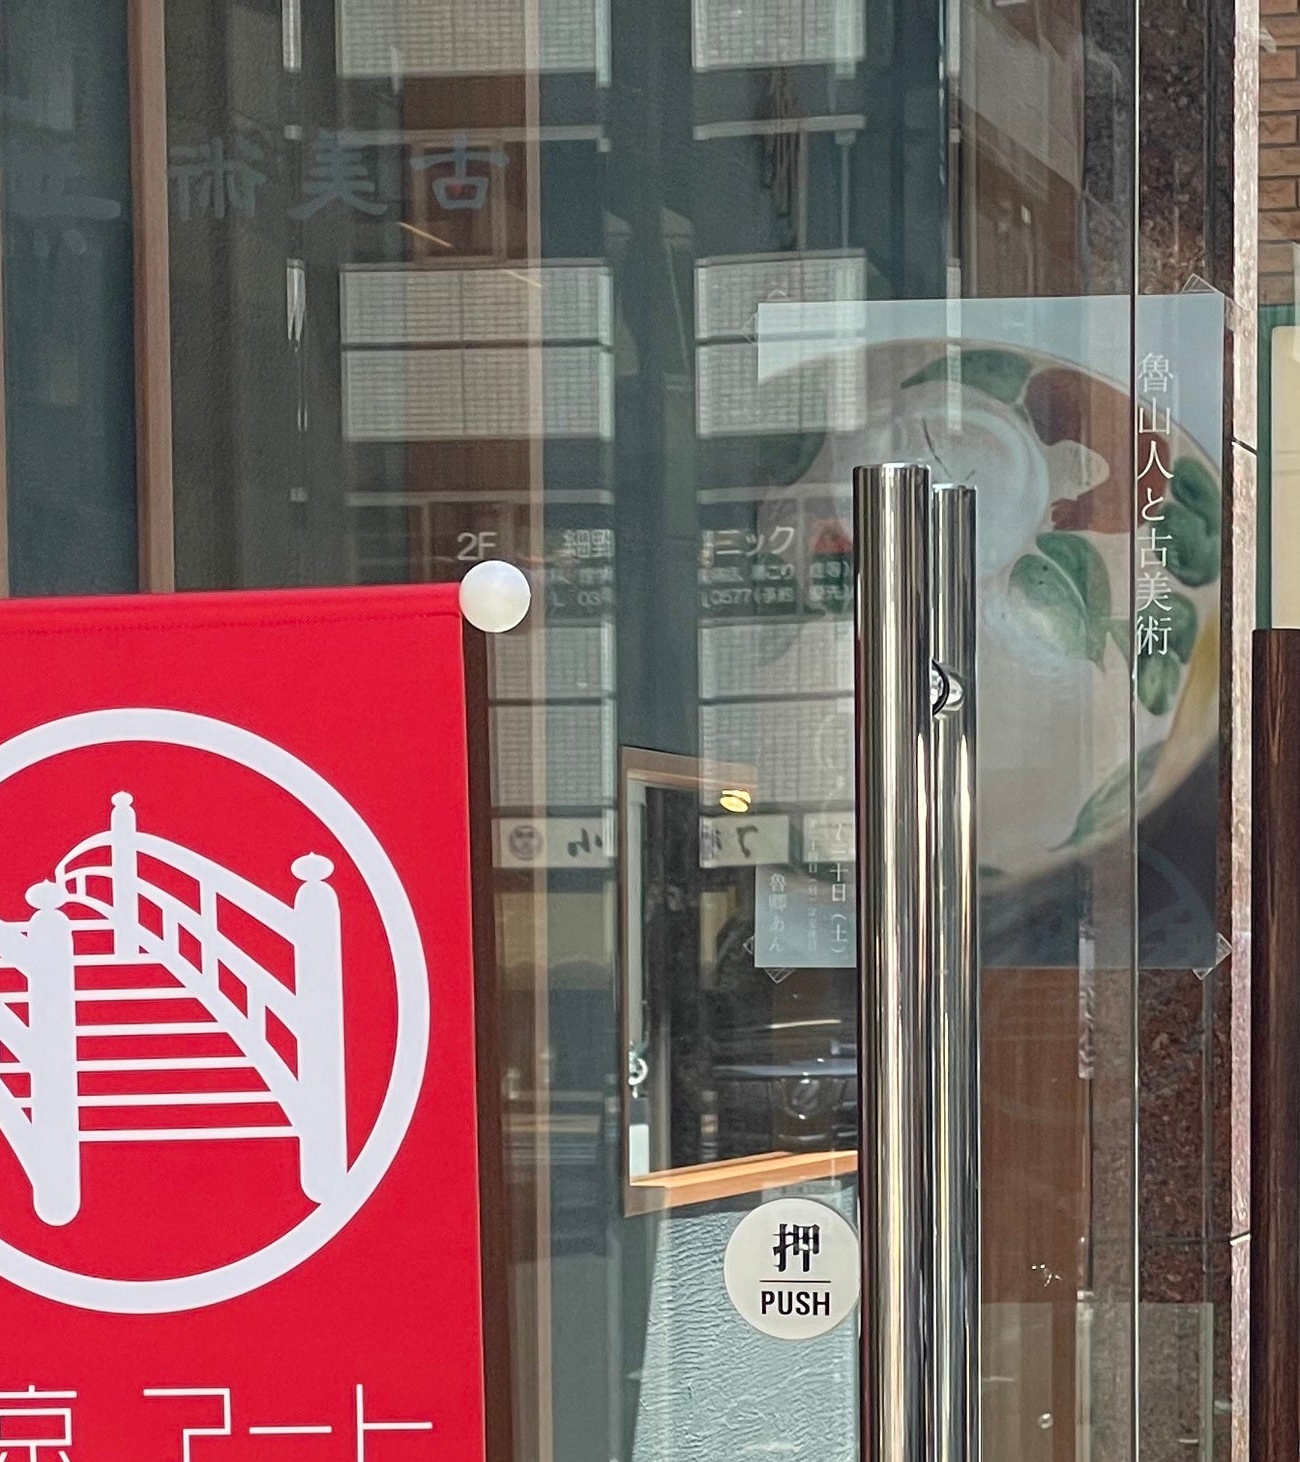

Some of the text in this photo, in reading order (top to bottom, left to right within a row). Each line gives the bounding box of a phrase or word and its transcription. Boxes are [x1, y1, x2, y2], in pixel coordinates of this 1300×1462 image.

[1136, 351, 1174, 656] 魯山人と古美術
[456, 531, 498, 561] 2F
[772, 1223, 820, 1273] 押
[760, 1290, 831, 1317] PUSH
